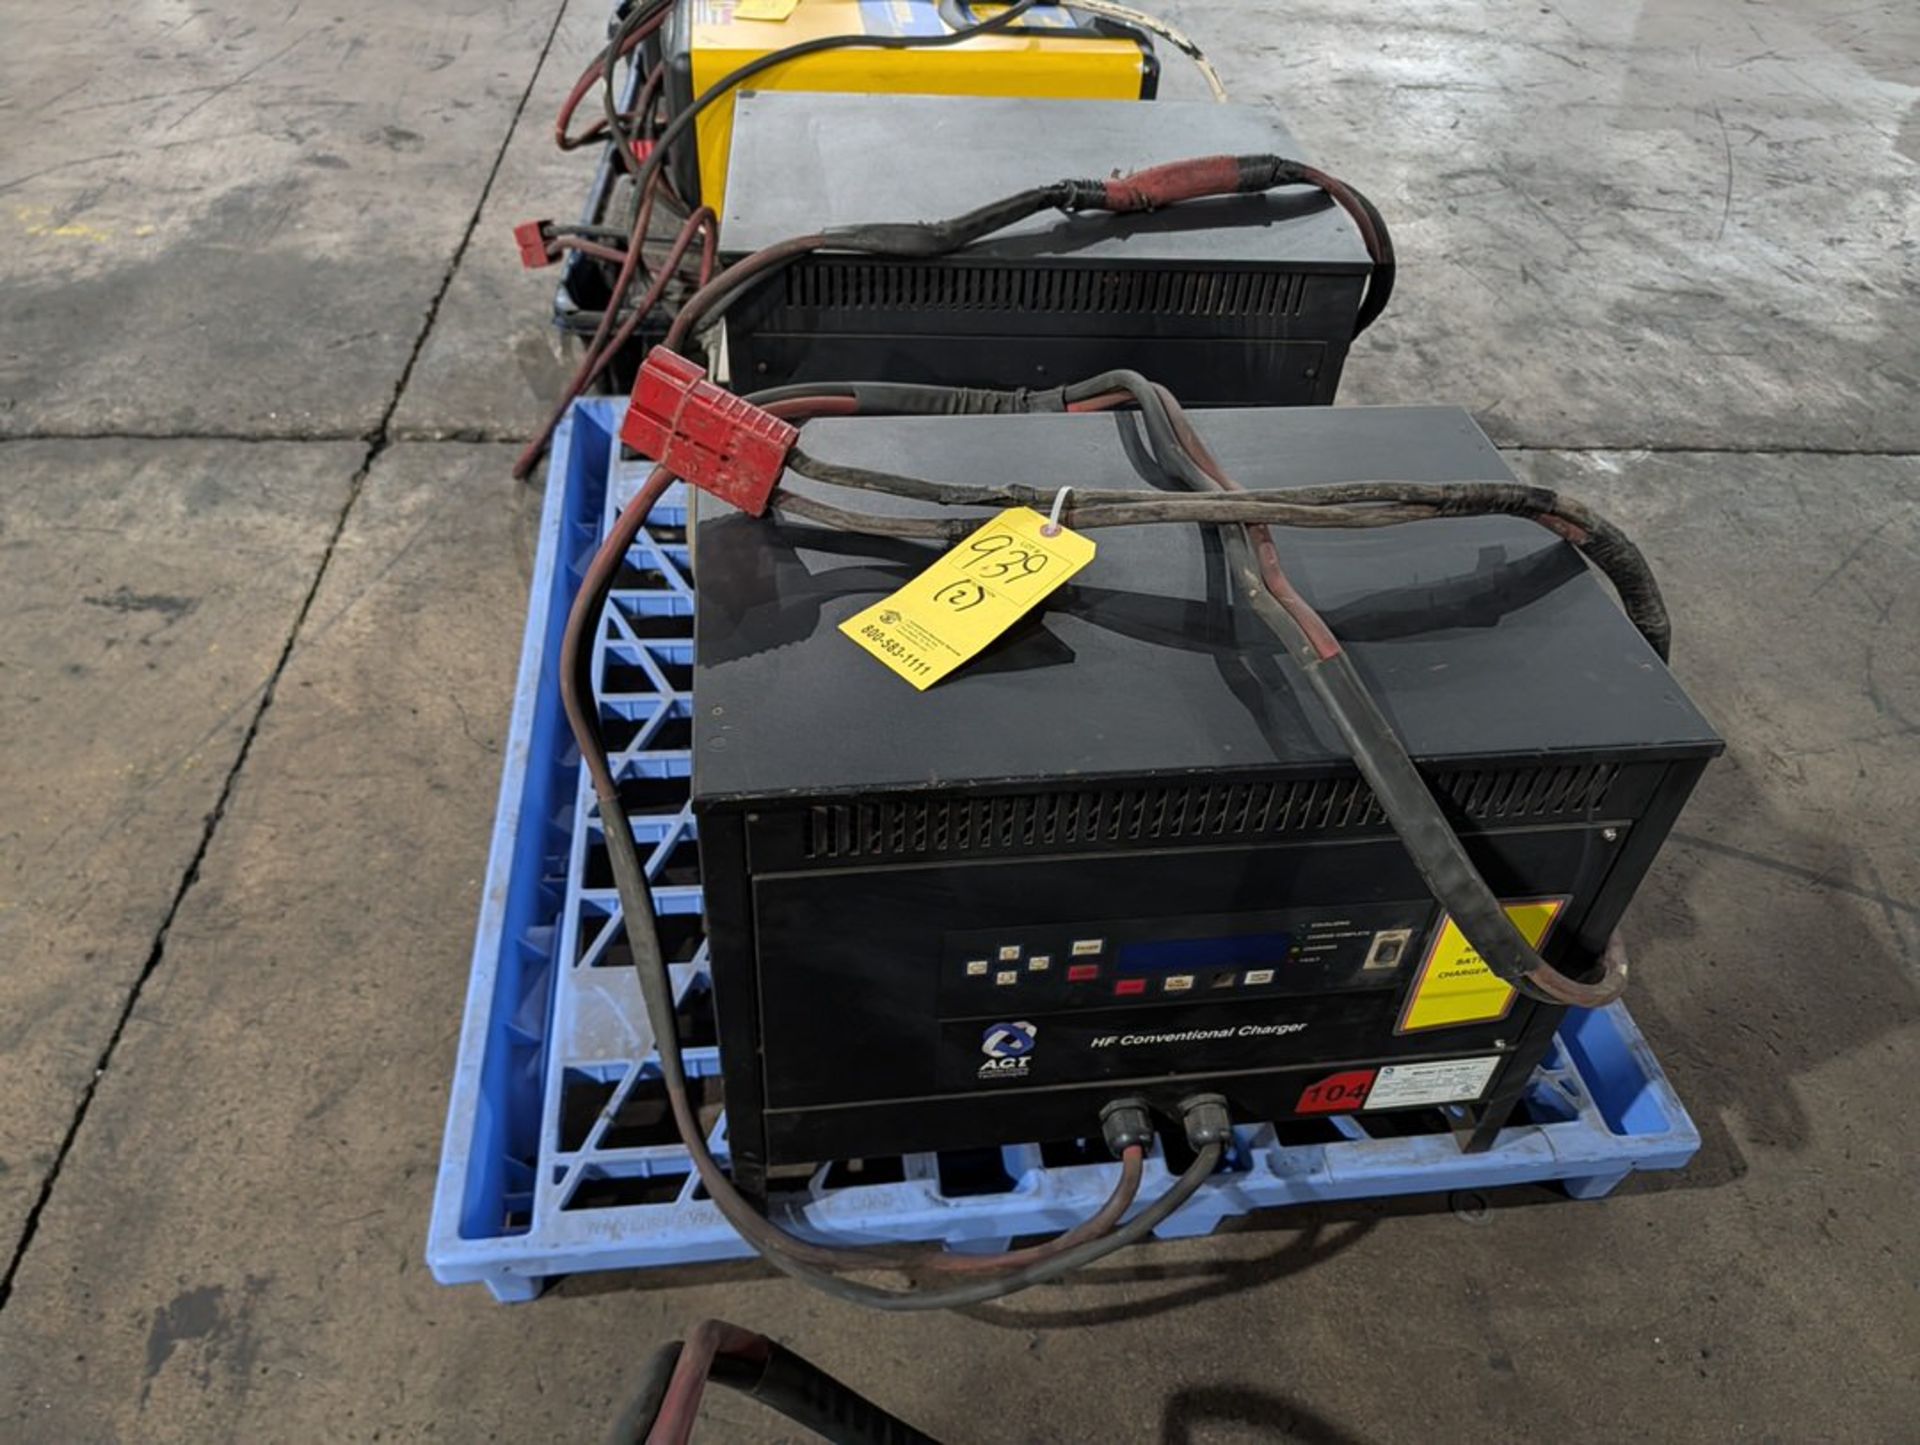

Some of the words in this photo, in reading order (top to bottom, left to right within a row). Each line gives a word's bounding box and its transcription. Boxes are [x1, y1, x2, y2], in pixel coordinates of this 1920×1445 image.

[962, 534, 1048, 584] 939
[860, 624, 932, 676] 800-583-1111
[1090, 1036, 1118, 1048] HF
[1120, 1027, 1235, 1046] Conventional
[1237, 1022, 1308, 1036] Charger
[1307, 1083, 1367, 1103] 104
